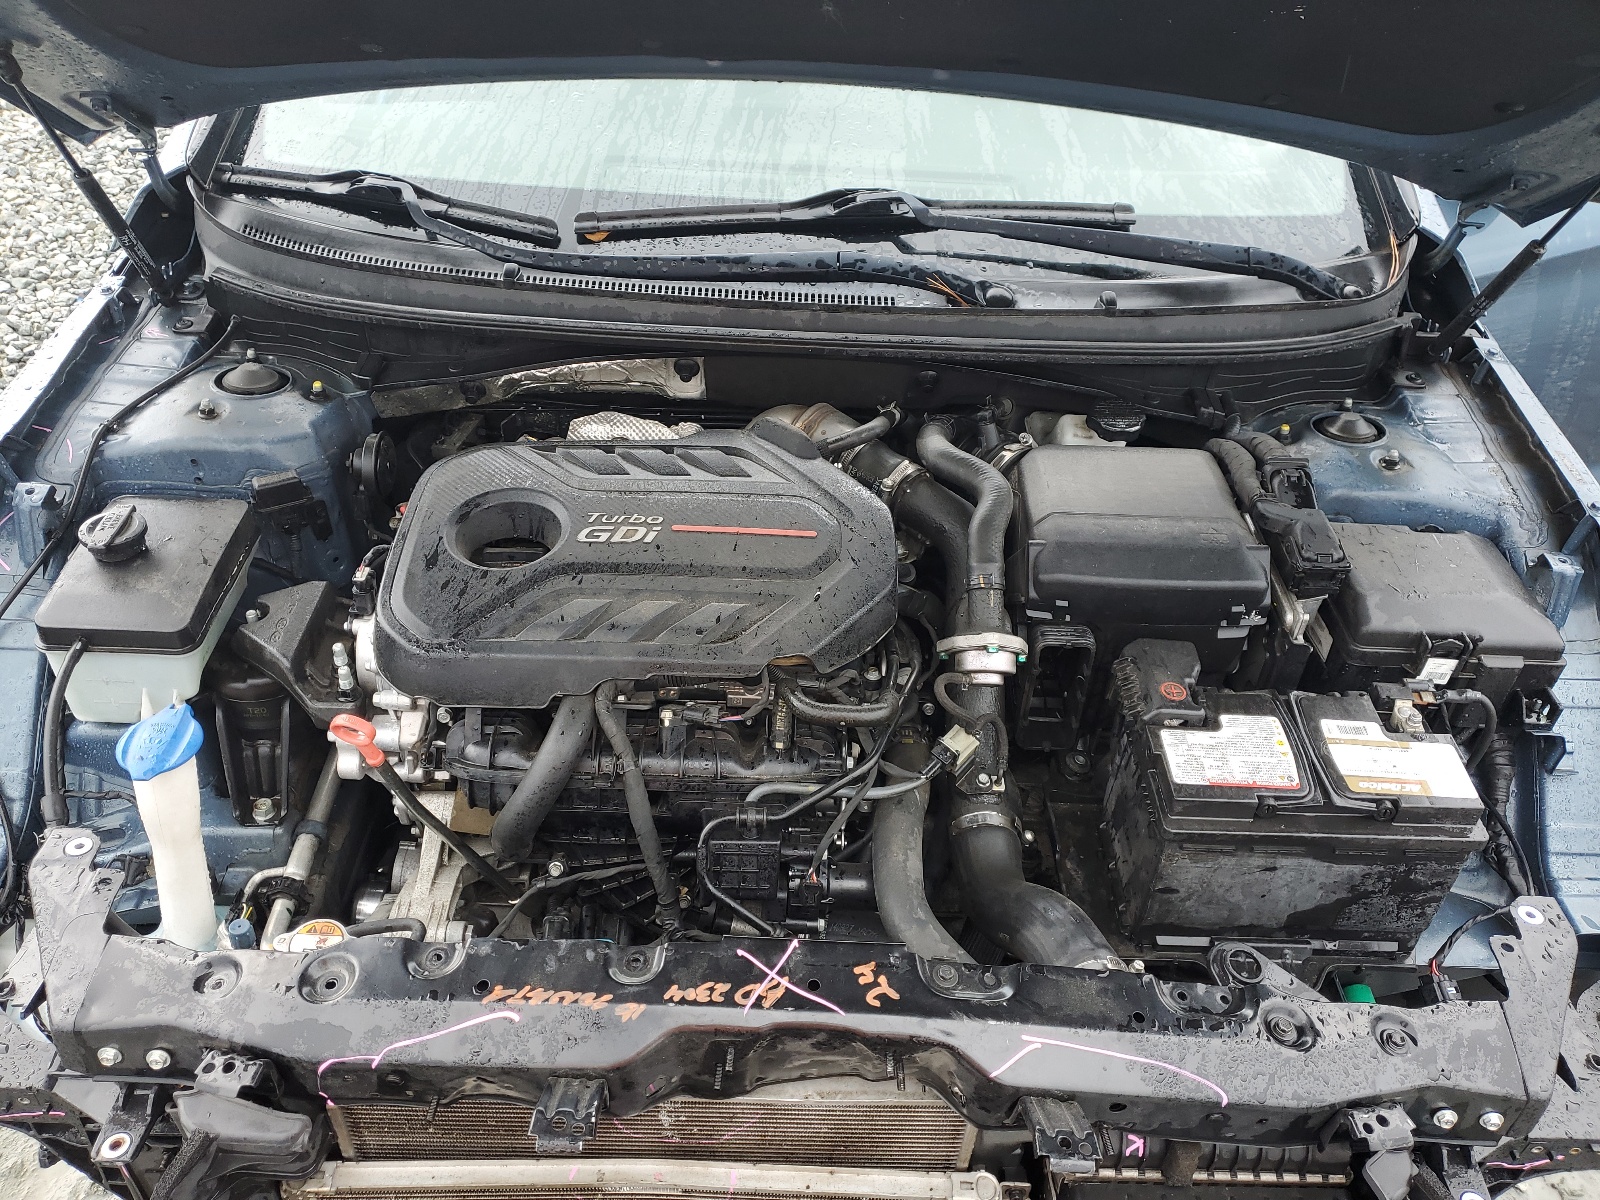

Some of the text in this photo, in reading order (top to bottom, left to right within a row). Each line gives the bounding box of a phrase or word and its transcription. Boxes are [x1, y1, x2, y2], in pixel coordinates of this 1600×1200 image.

[587, 512, 664, 524] Turbo
[577, 526, 662, 543] GDi
[664, 983, 731, 1002] 2304
